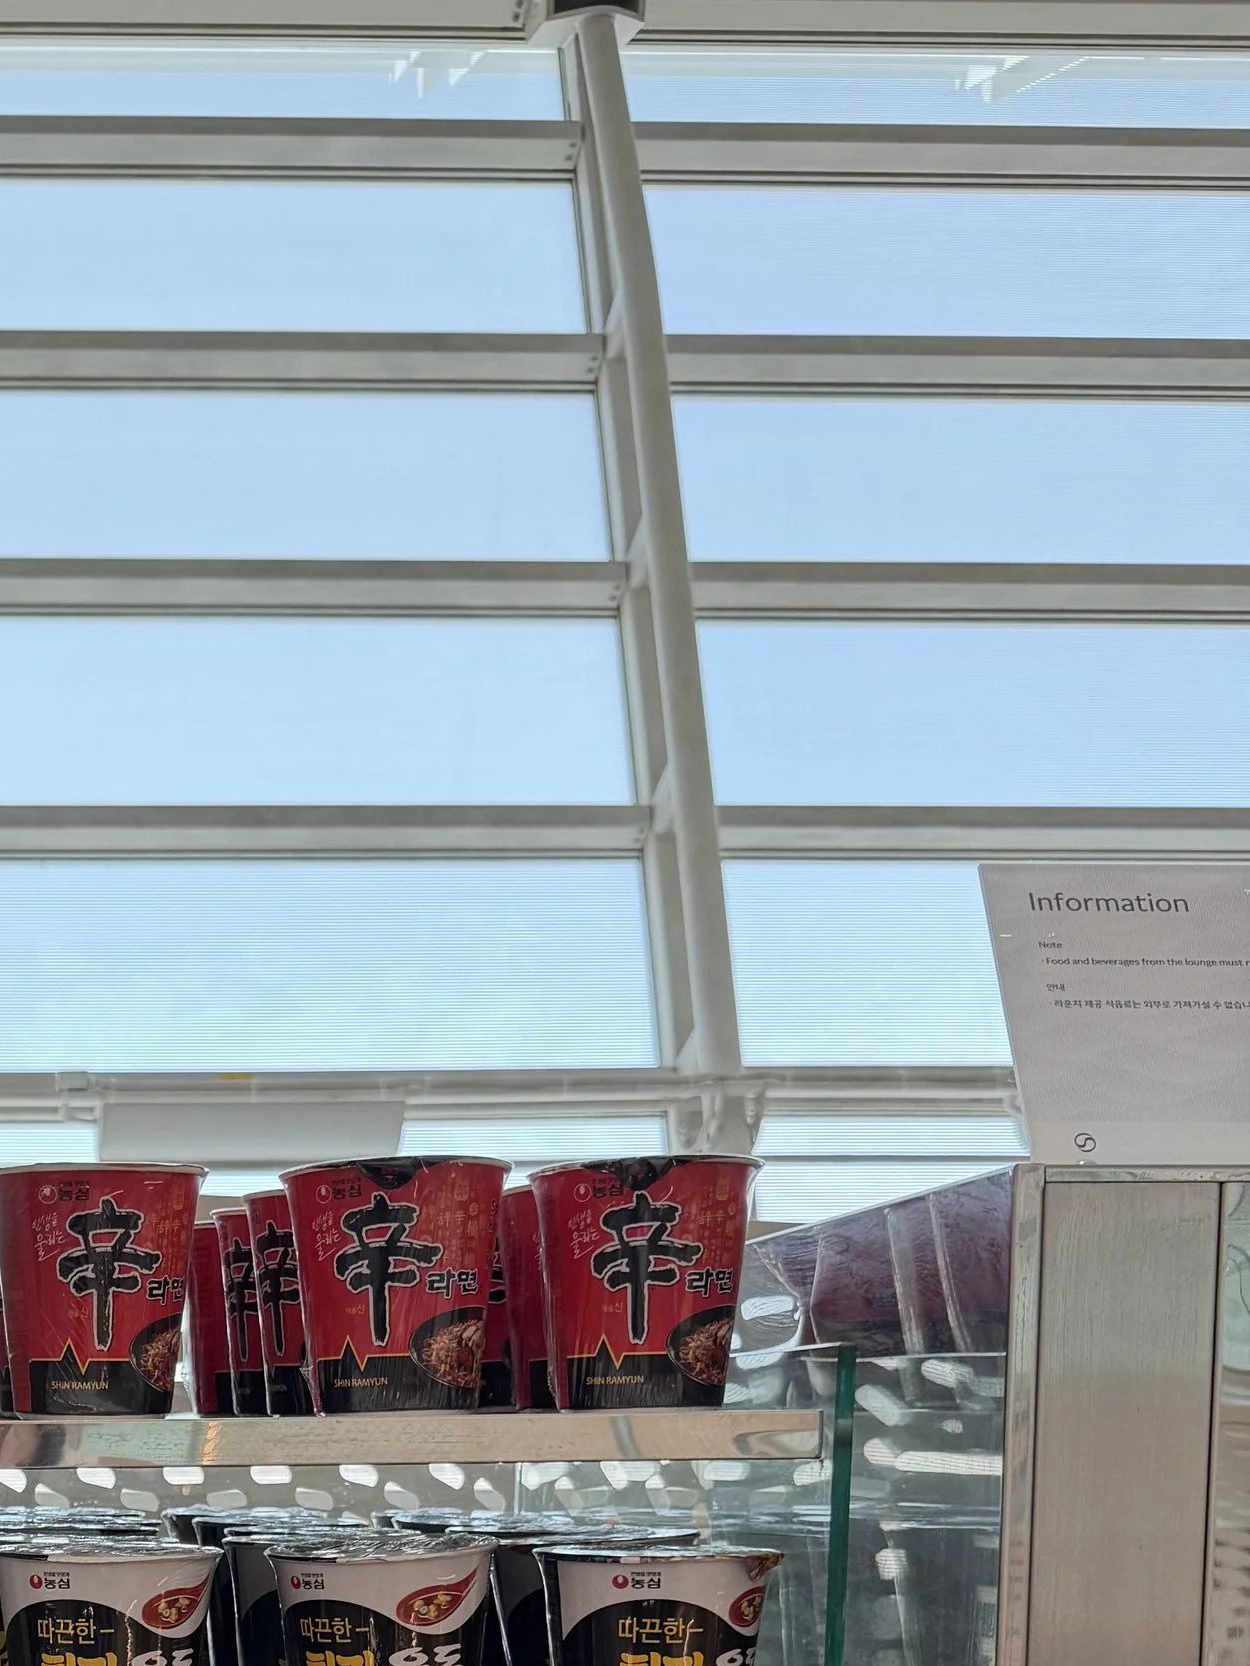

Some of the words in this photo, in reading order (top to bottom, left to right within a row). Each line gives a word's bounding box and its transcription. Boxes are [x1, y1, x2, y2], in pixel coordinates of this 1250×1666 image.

[1028, 892, 1190, 913] Information
[1038, 941, 1063, 949] Note
[1046, 958, 1070, 966] Food
[1072, 958, 1090, 966] and
[1091, 958, 1140, 966] beverages
[1142, 958, 1166, 966] from
[1166, 958, 1183, 966] the
[1184, 958, 1218, 966] lounge
[1219, 958, 1244, 966] must
[1046, 983, 1066, 992] 안내
[56, 1197, 163, 1352] 辛
[334, 1191, 444, 1347] 辛
[591, 1190, 704, 1346] 辛
[146, 1275, 186, 1306] 라면
[425, 1268, 480, 1299] 라면
[685, 1266, 734, 1297] 라면
[50, 1380, 70, 1390] SHIN
[72, 1380, 109, 1390] RAMYUN
[334, 1379, 350, 1388] SHIN
[352, 1376, 388, 1387] RAMYUN
[586, 1376, 605, 1386] SHIN
[606, 1376, 644, 1385] RAMYUN
[43, 1577, 71, 1589] 농심
[302, 1578, 325, 1590] 농심
[630, 1577, 662, 1590] 농심
[37, 1618, 97, 1645] 따끈한
[300, 1617, 352, 1643] 따끈한
[618, 1617, 683, 1645] 따끈한
